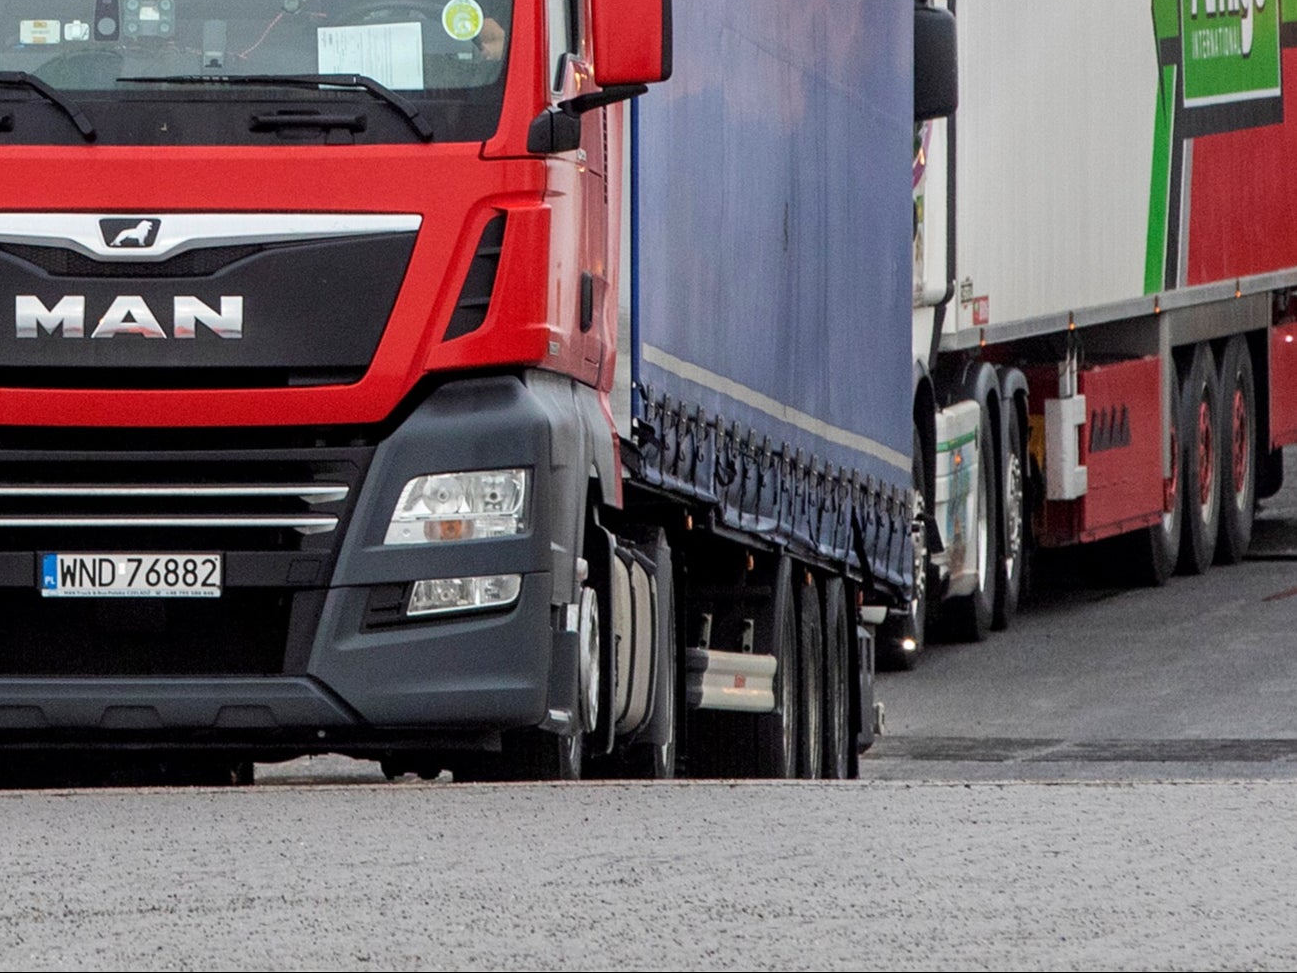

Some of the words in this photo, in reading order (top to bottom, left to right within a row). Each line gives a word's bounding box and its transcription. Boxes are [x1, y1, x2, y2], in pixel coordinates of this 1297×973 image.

[16, 295, 243, 339] MAN
[60, 558, 116, 587] WND
[127, 558, 217, 587] 76882
